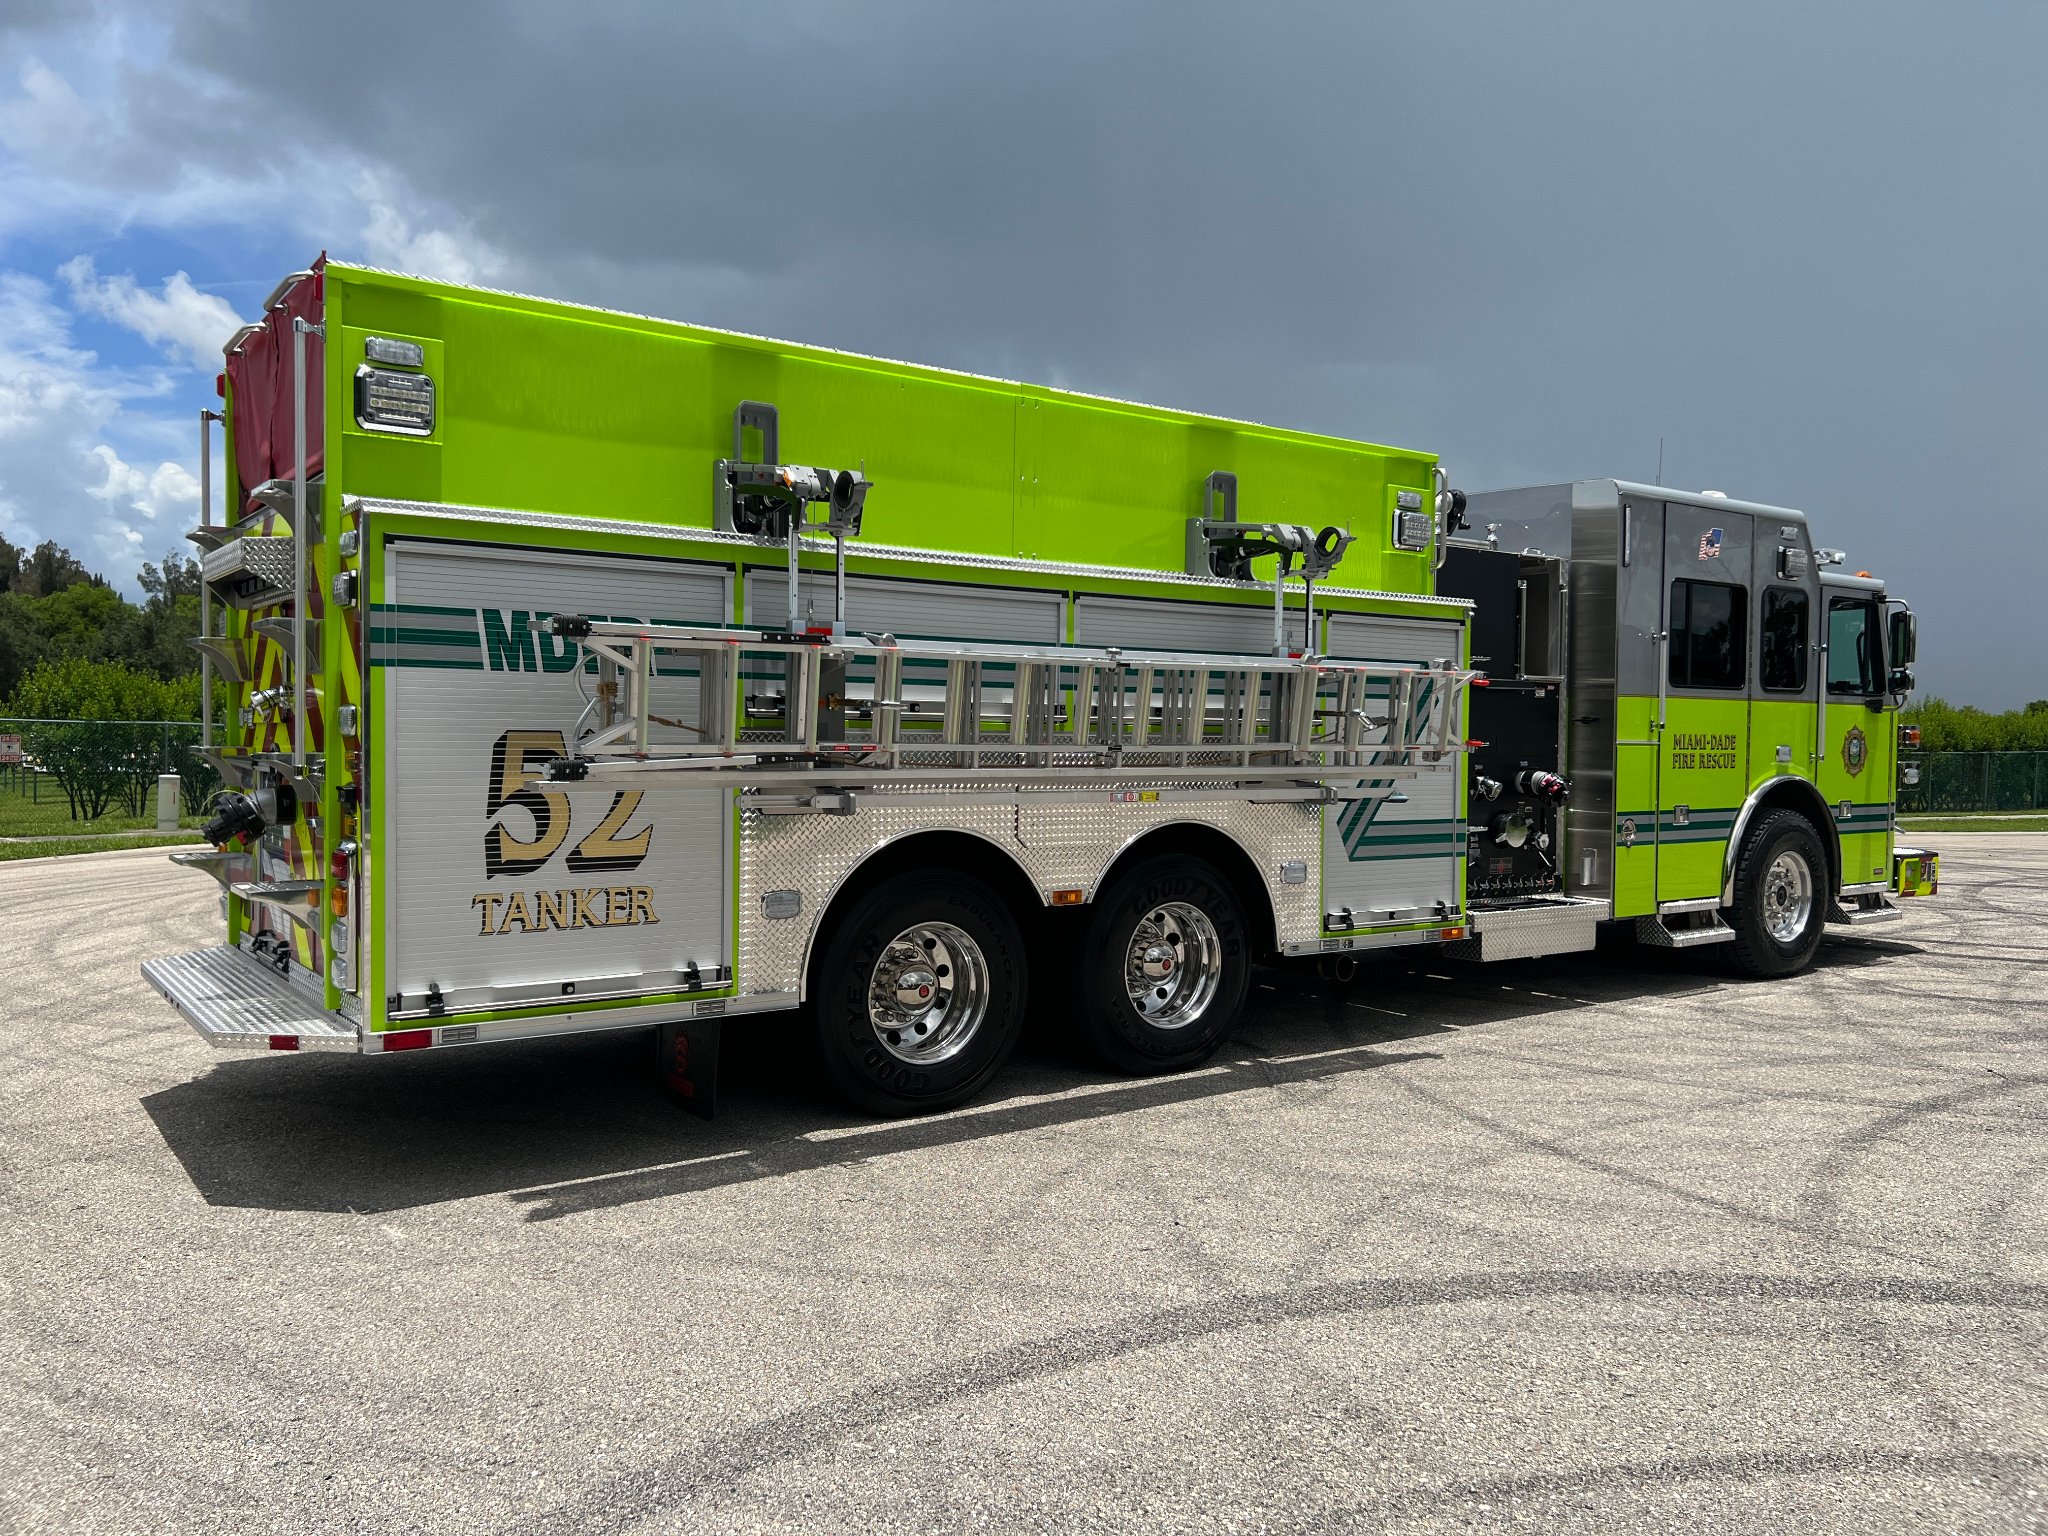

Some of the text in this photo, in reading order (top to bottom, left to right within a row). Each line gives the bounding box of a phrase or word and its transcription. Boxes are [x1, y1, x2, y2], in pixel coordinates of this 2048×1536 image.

[1672, 753, 1736, 769] FIRE RESCUE
[1673, 734, 1736, 750] MIAMI-DADE
[471, 886, 660, 936] TANKER
[948, 896, 1013, 986] ENDURANCE
[1133, 880, 1240, 957] GOODYEAR
[847, 934, 930, 1089] GOODYEAR
